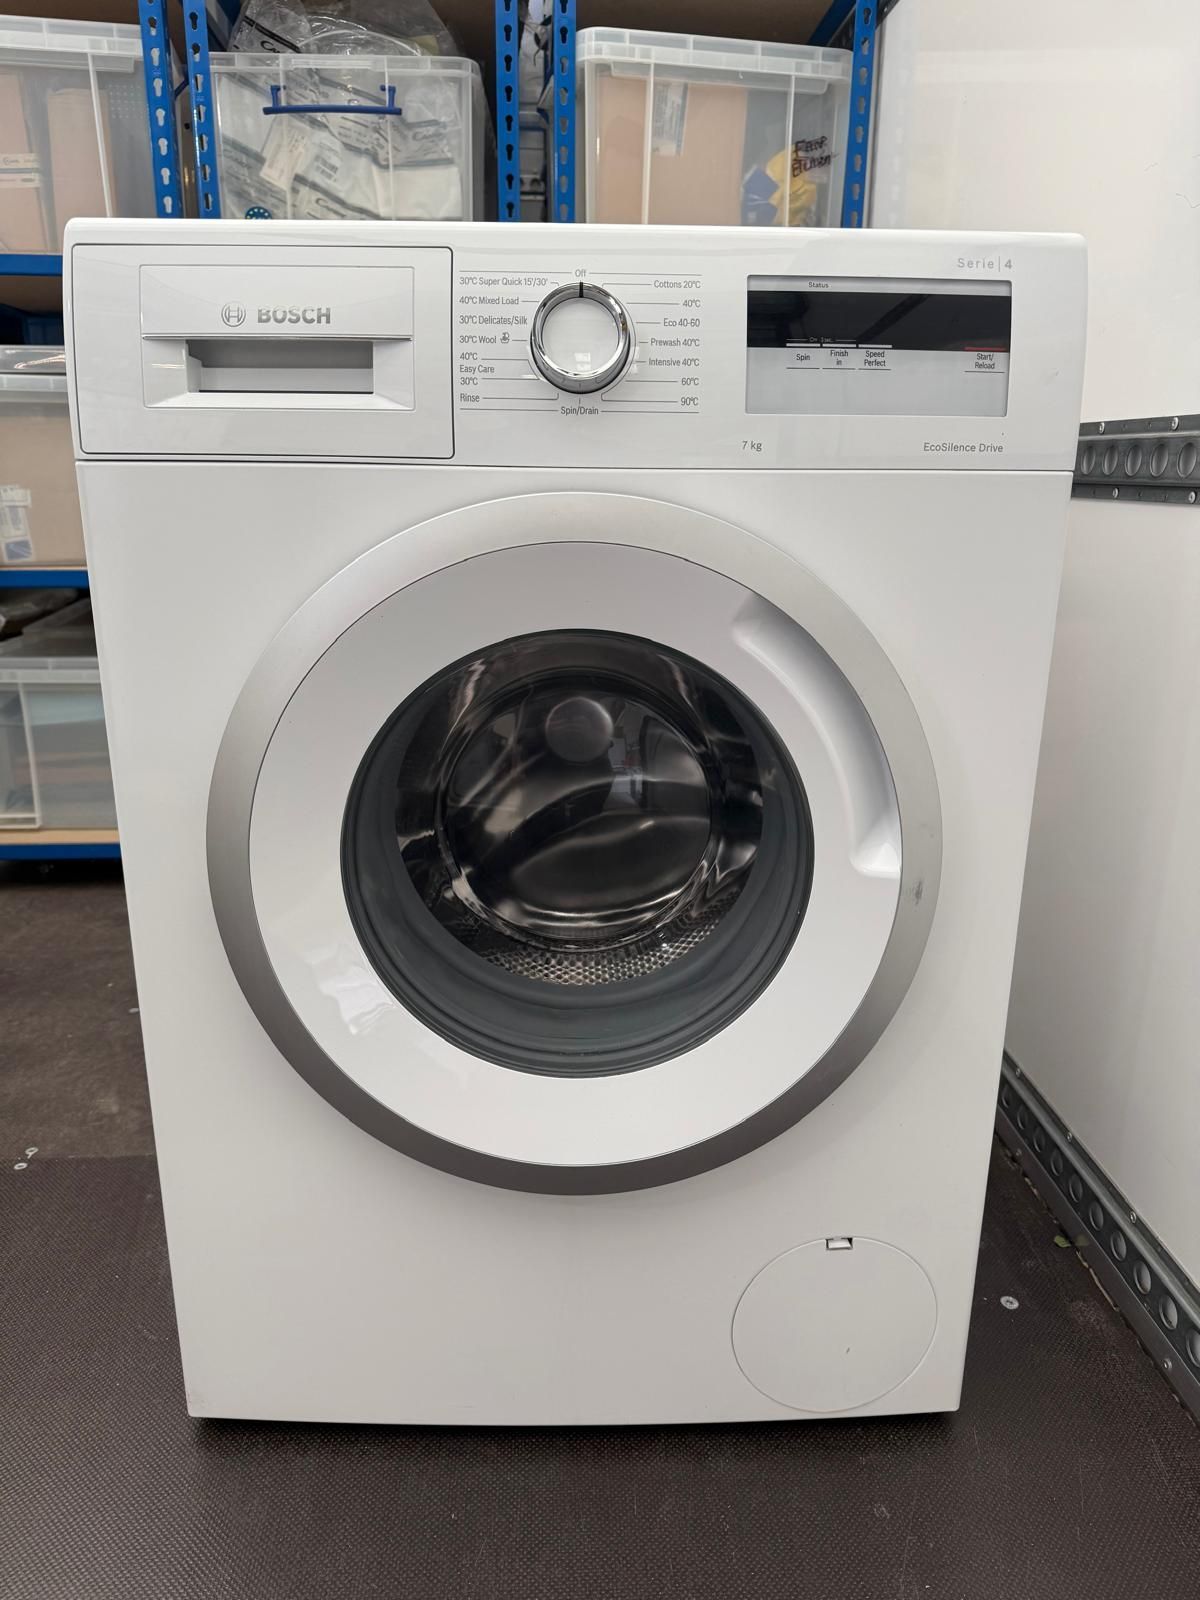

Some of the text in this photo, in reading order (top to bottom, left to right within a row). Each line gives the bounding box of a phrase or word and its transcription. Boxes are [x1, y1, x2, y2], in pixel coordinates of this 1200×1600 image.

[574, 269, 587, 277] Off
[459, 277, 548, 287] 30°C Super Quick 15'/30'
[653, 280, 701, 289] Cottons 20°C
[808, 281, 829, 289] Status
[459, 296, 519, 305] 40°C Mixed Load
[682, 300, 701, 308] 40°C
[257, 307, 331, 324] BOSCH
[459, 316, 528, 326] 30°C Delicates/Silk
[663, 319, 700, 327] Eco 40-60
[459, 335, 497, 344] 30°C Wool
[650, 338, 700, 347] Prewash 40°C
[459, 352, 478, 361] 40°C
[796, 353, 811, 361] Spin
[830, 349, 849, 357] Finish
[865, 350, 885, 358] Speed
[976, 352, 994, 363] Start/
[648, 358, 700, 367] Intensive 40°C
[864, 359, 886, 367] Perfect
[975, 361, 995, 370] Reload
[459, 365, 495, 375] Easy Care
[460, 377, 478, 386] 30°C
[681, 378, 700, 386] 60°C
[460, 393, 480, 402] Rinse
[680, 397, 699, 406] 90°C
[560, 406, 599, 417] Spin/Drain
[742, 440, 762, 452] 7 kg
[923, 442, 1003, 453] EcoSilence Drive
